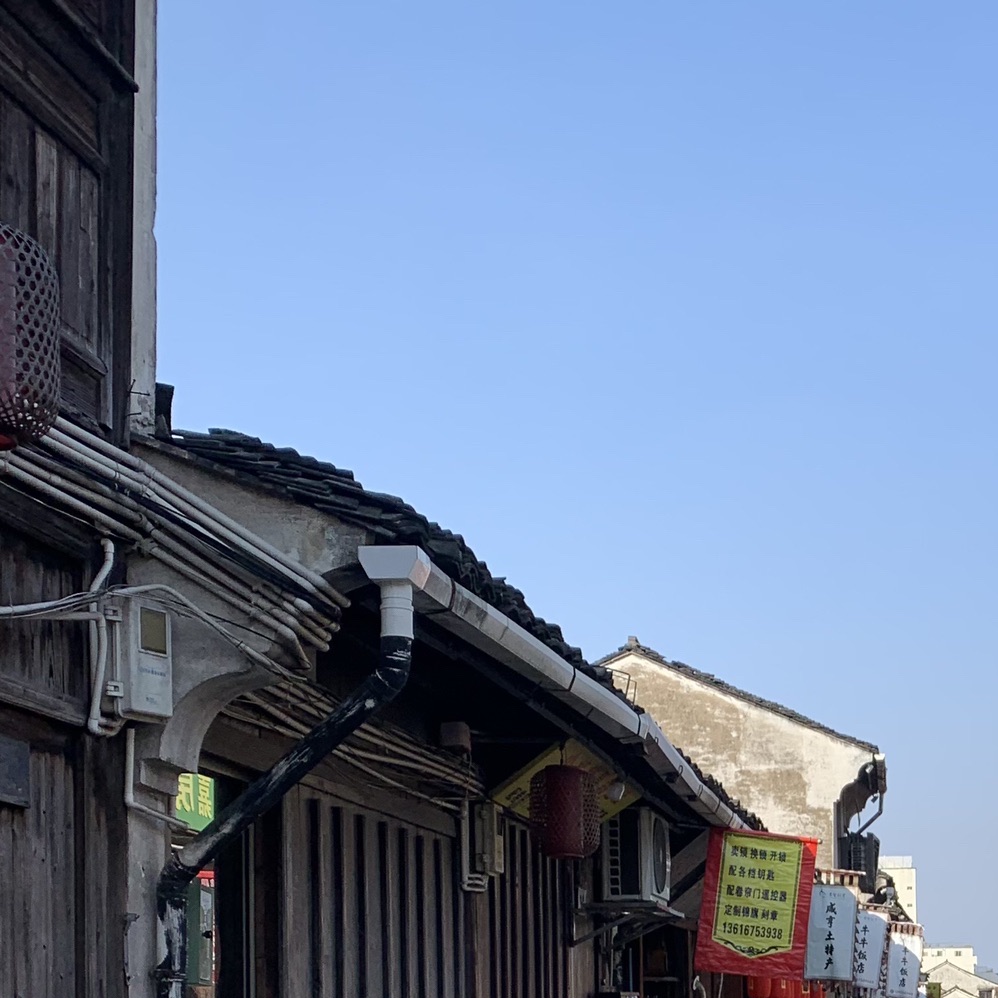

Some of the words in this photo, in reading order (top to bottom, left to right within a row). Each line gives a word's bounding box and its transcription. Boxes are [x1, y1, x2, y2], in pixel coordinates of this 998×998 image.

[824, 902, 837, 970] 咸亨土特产
[856, 925, 869, 974] 牛牛饭店
[898, 946, 909, 988] 牛牛饭店
